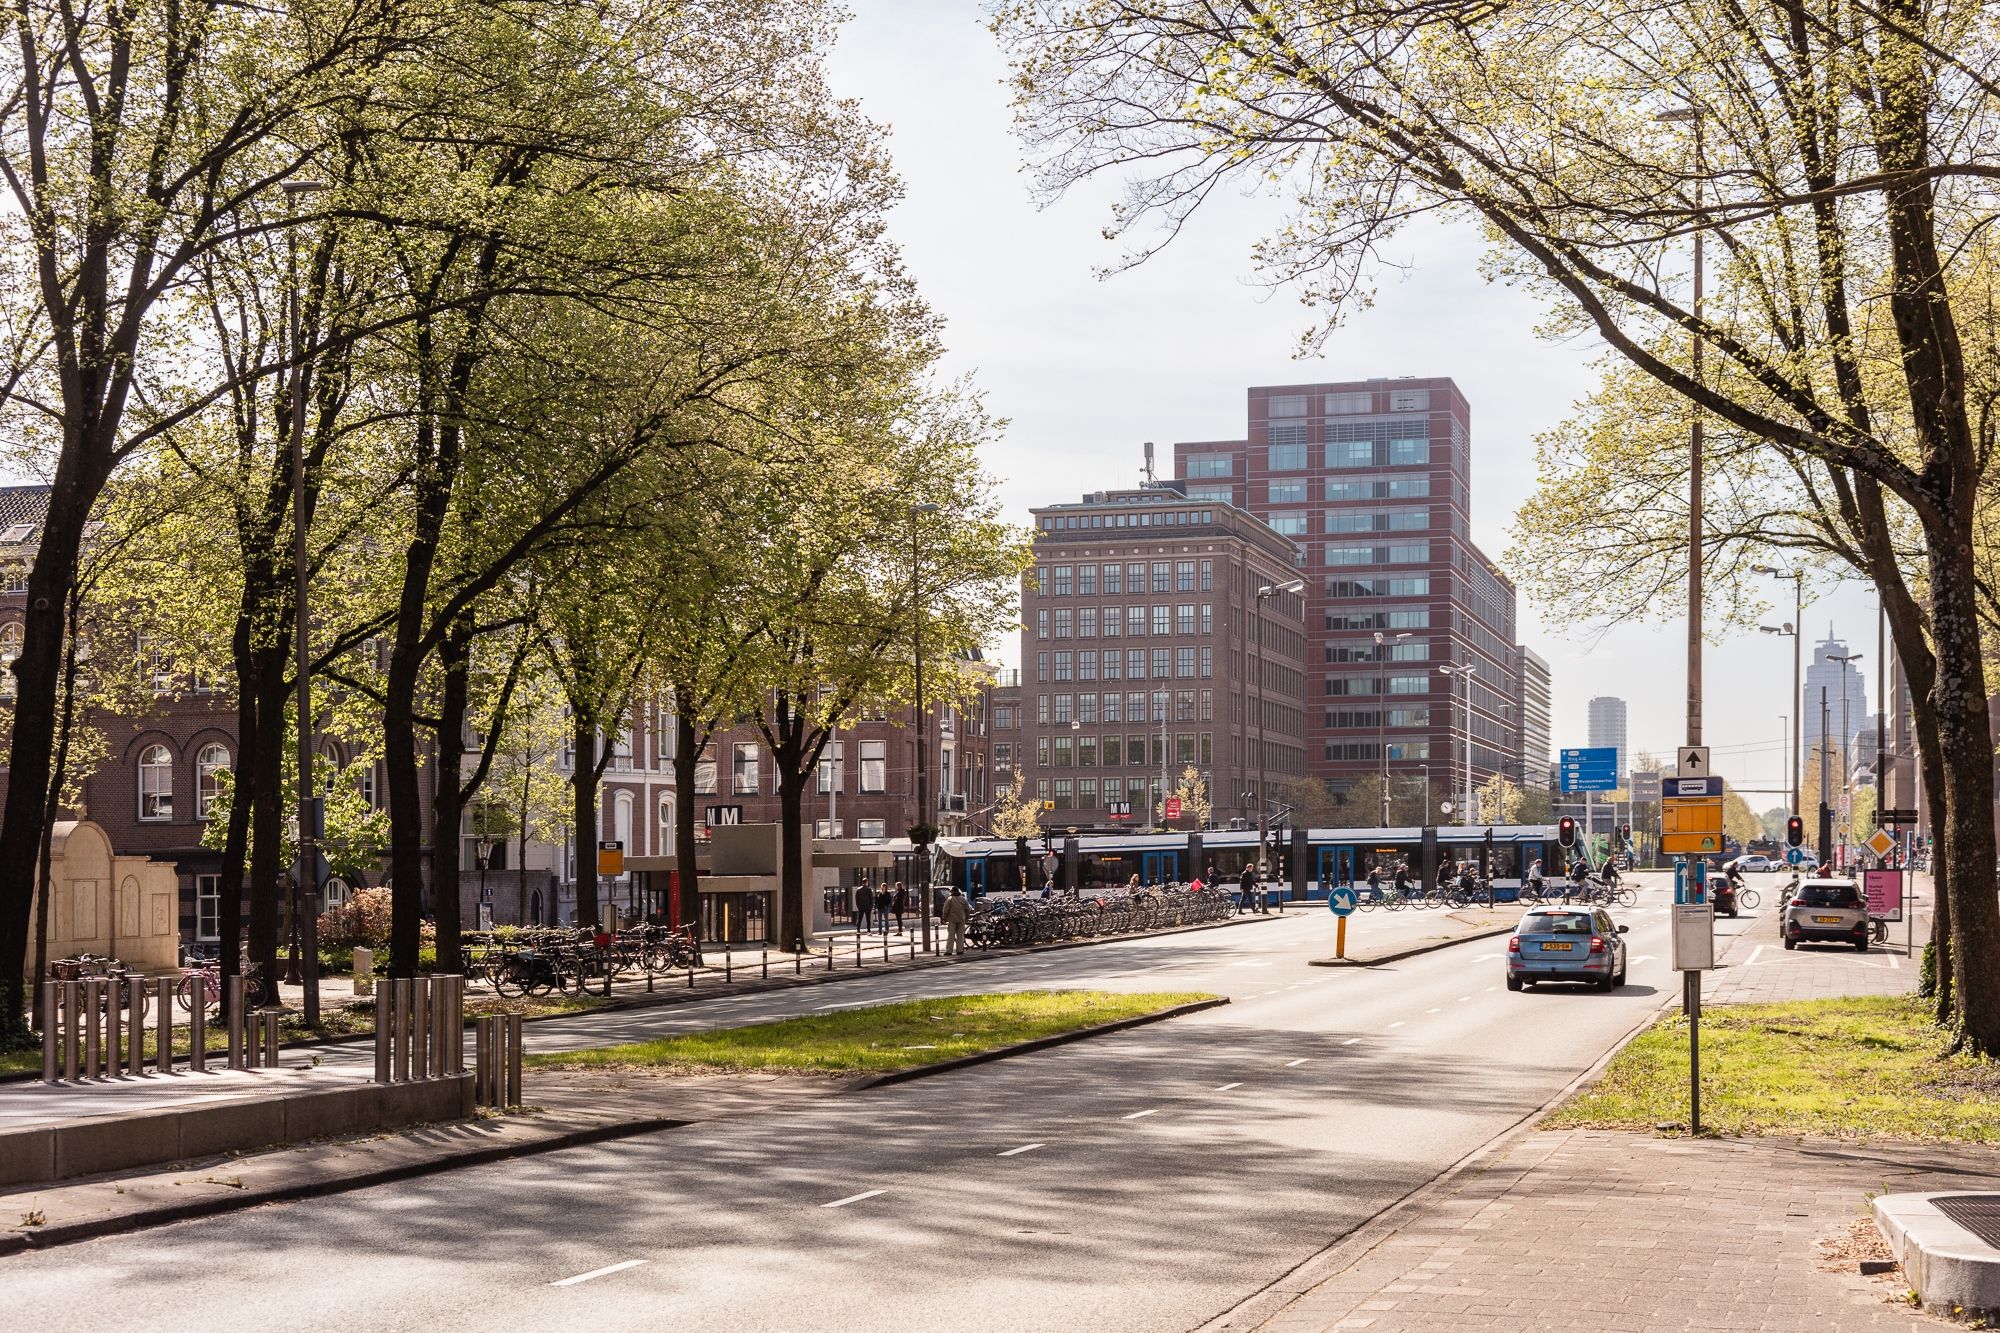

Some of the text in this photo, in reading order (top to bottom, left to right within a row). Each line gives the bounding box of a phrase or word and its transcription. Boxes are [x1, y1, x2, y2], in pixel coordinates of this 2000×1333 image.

[1111, 803, 1130, 814] M M
[721, 807, 738, 826] M
